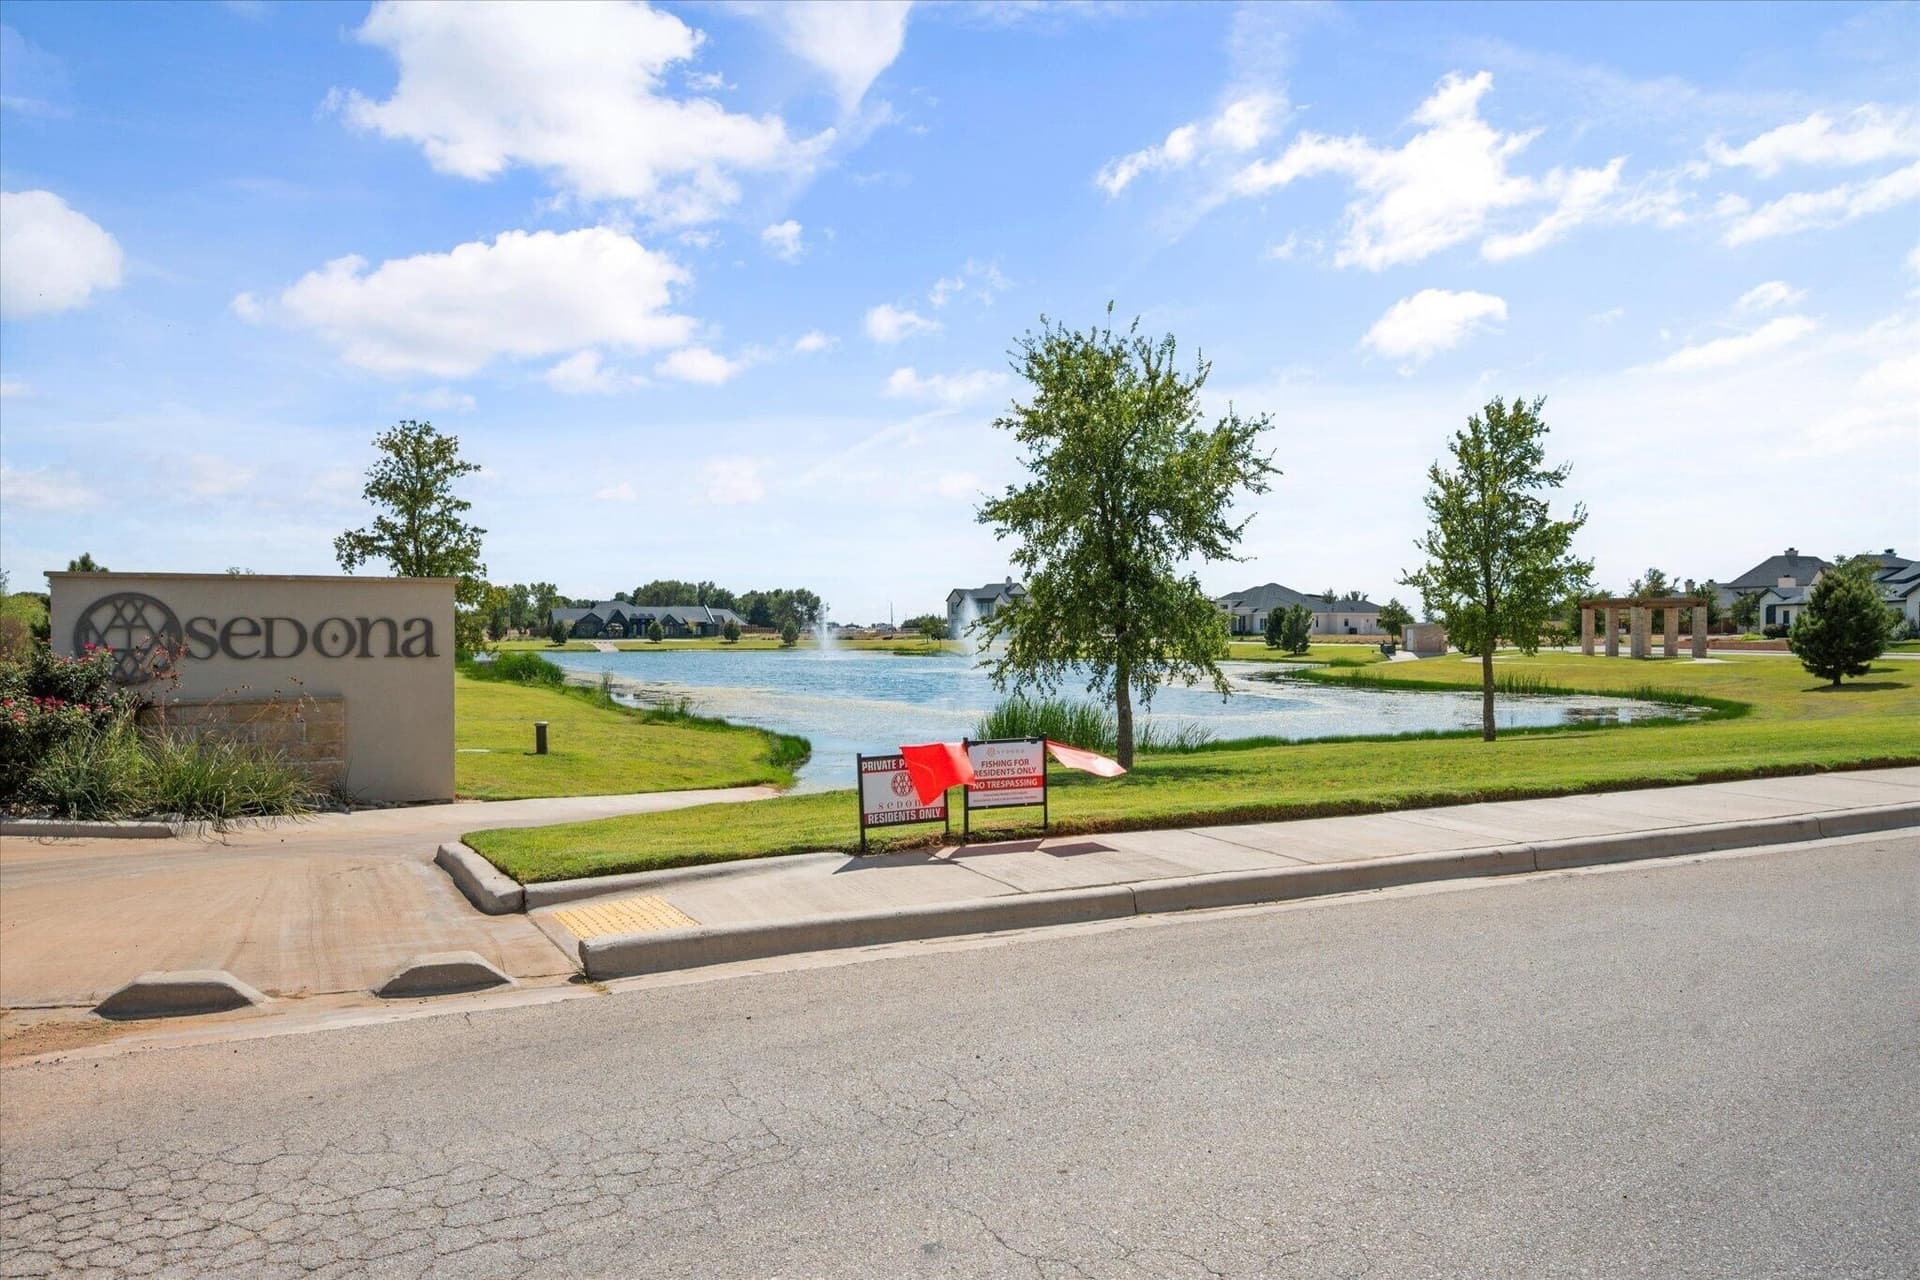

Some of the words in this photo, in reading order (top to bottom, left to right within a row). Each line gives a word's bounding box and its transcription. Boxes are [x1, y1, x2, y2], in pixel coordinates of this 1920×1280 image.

[862, 760, 897, 772] PRIVATE
[981, 760, 1013, 769] FISHING
[1014, 759, 1029, 767] FOR
[974, 768, 1016, 777] RESIDENTS
[1017, 767, 1037, 775] ONLY
[972, 781, 985, 790] NO
[986, 778, 1038, 789] TRESPASSING
[868, 810, 917, 824] RESIDENTS
[919, 807, 941, 820] ONLY
